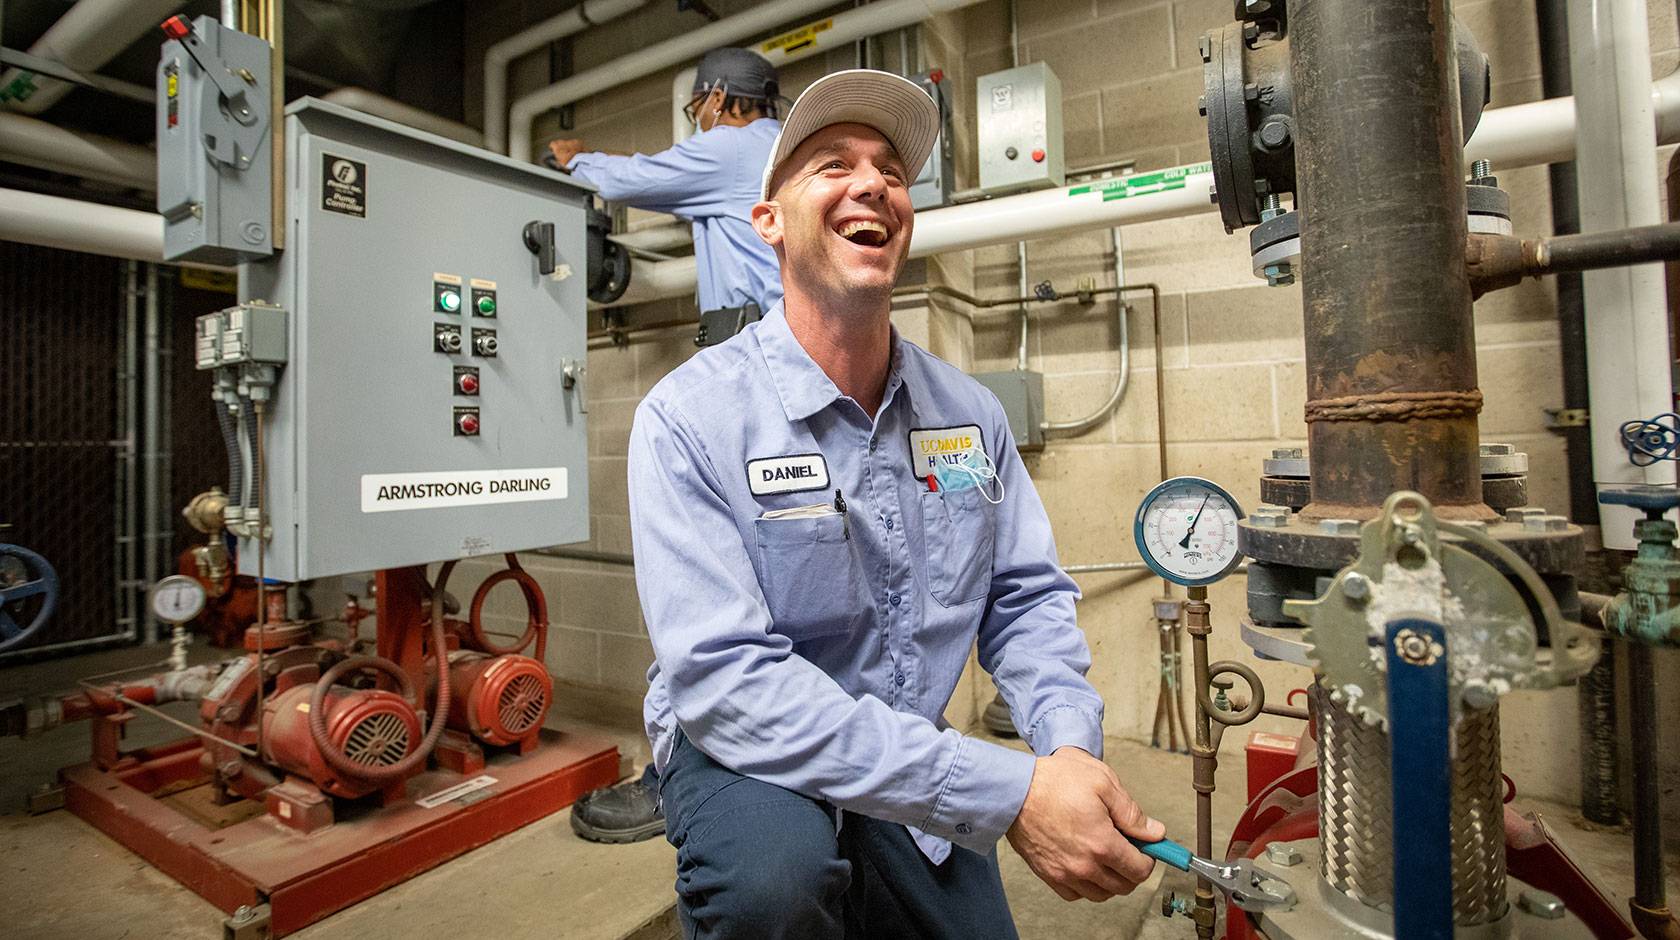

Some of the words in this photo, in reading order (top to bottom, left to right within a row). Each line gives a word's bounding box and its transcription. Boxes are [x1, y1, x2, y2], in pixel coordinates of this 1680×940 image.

[325, 197, 364, 212] Controller
[333, 192, 358, 205] Pump
[762, 465, 818, 482] DANIEL
[377, 481, 483, 501] ARMSTRONG
[490, 478, 551, 494] DARLING
